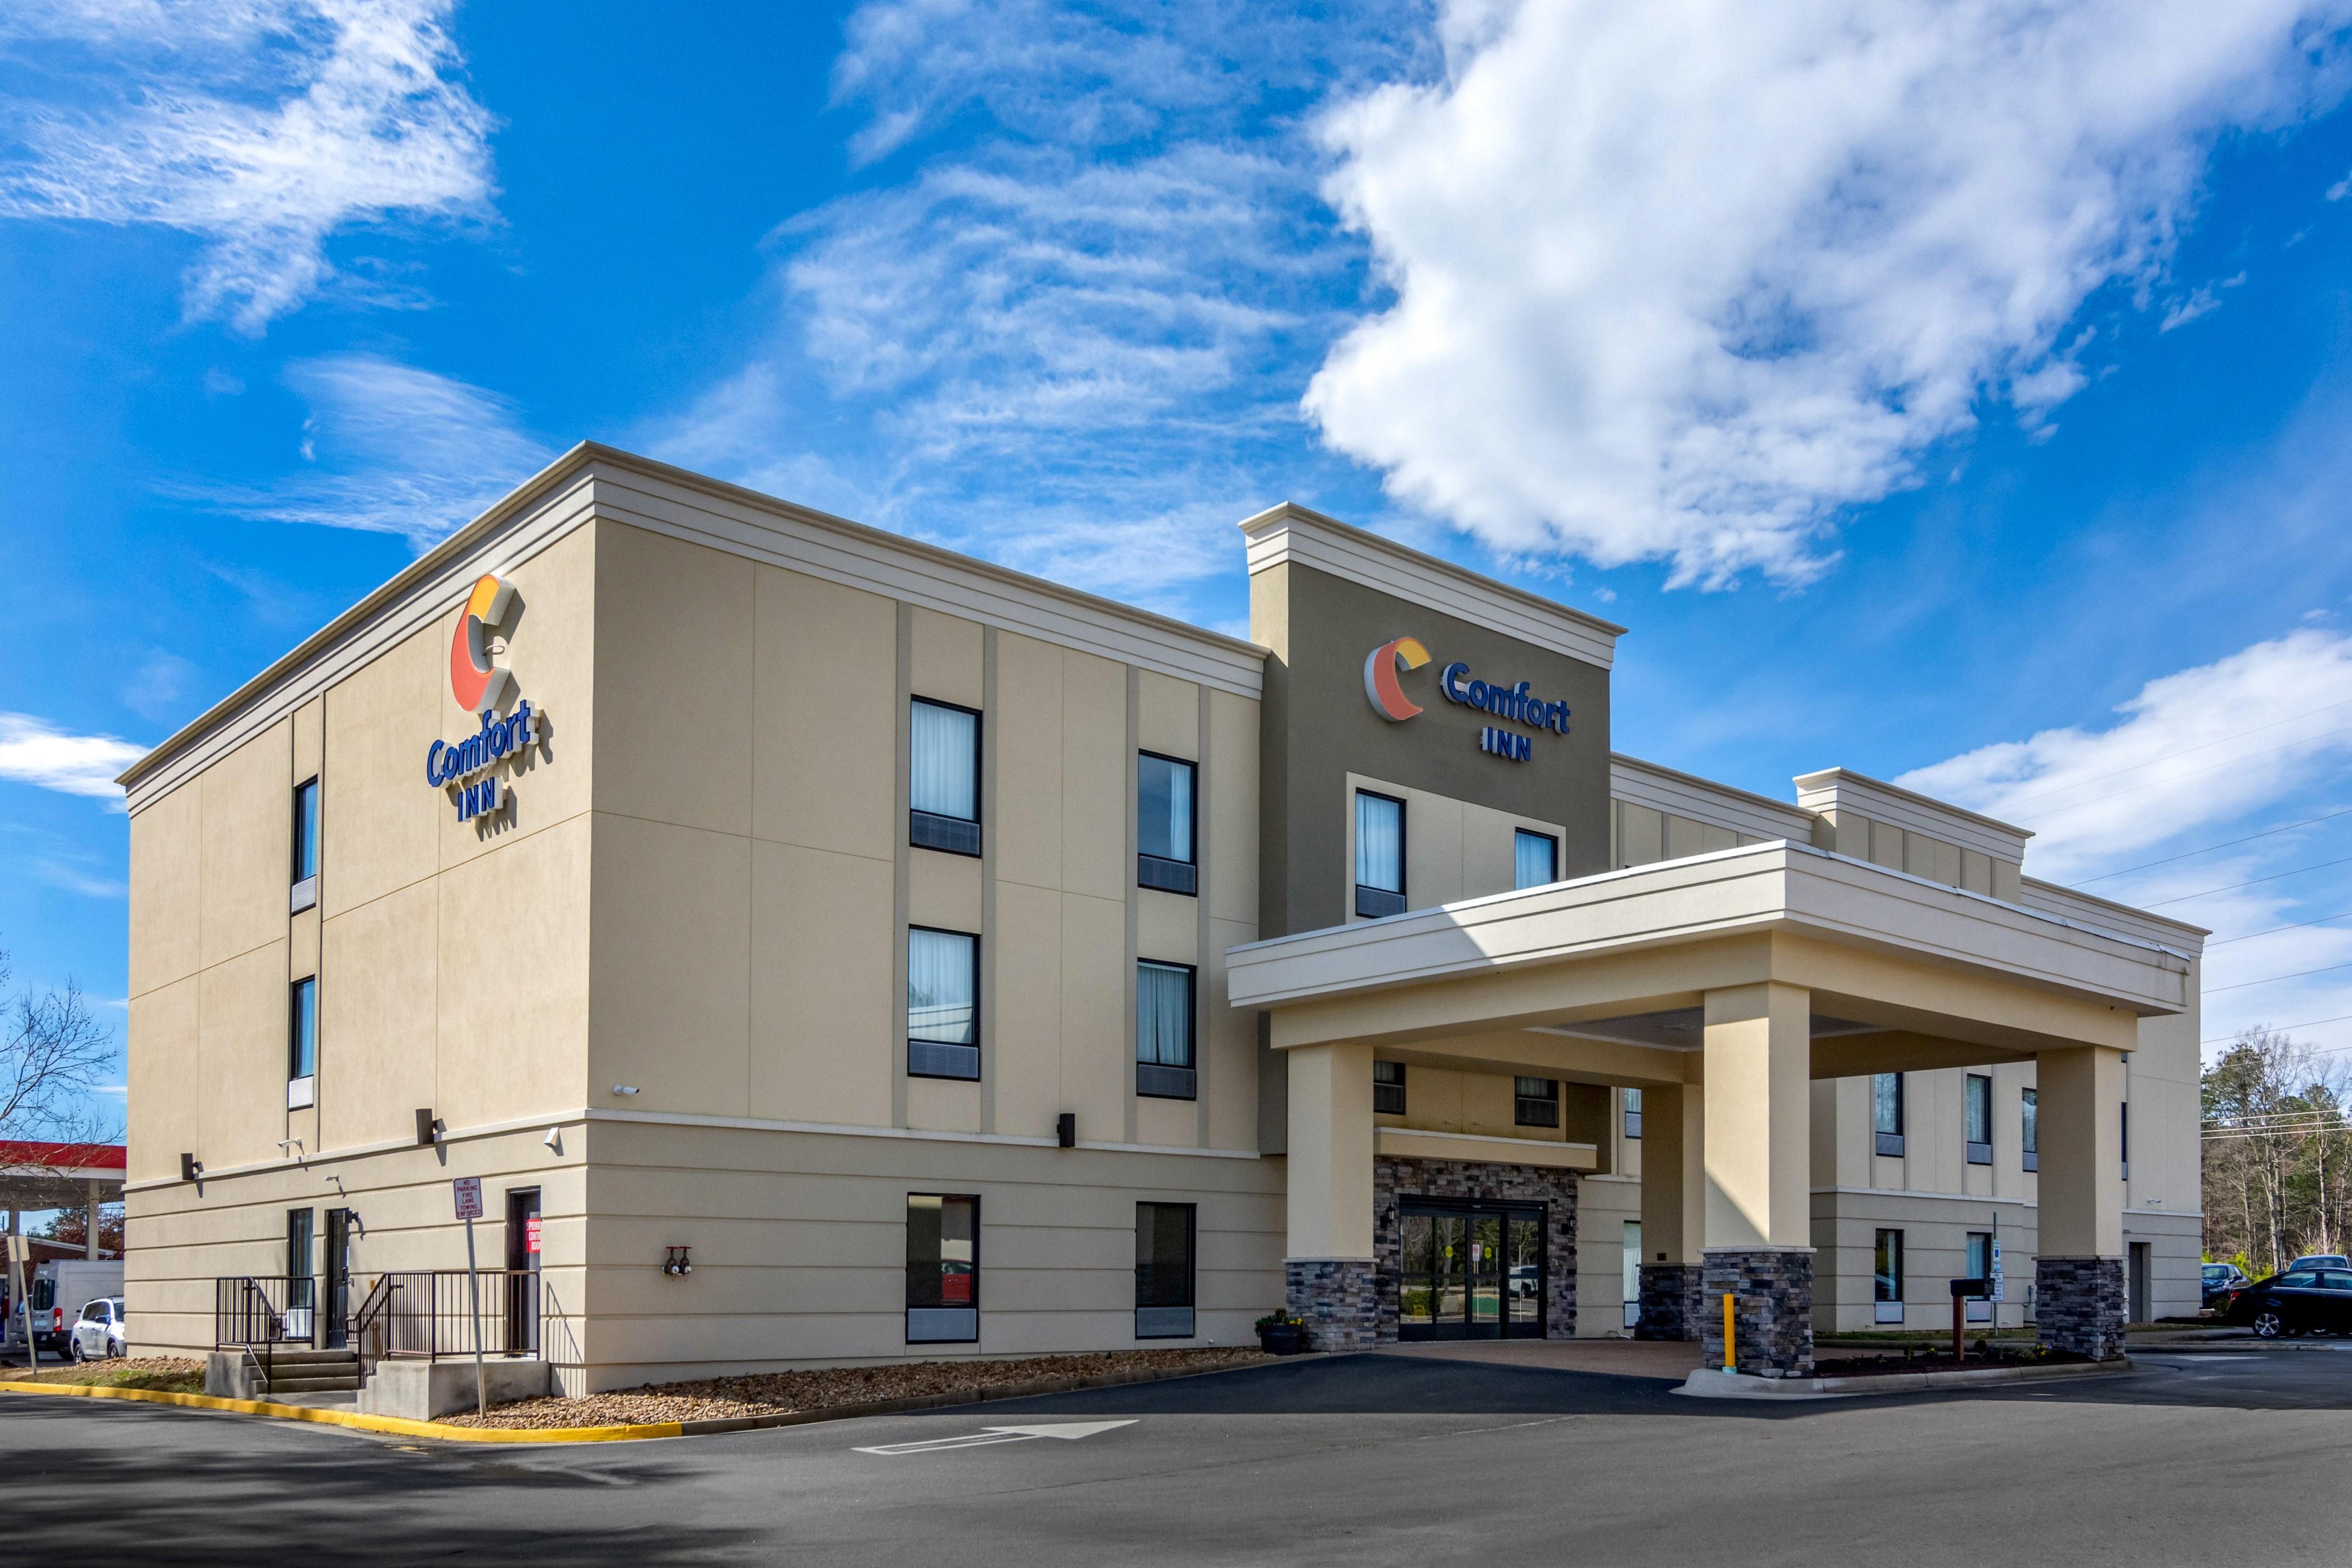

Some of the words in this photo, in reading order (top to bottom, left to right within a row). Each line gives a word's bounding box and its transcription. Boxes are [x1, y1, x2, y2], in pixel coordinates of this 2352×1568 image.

[1445, 662, 1570, 734] Comfort
[427, 699, 531, 787] Comfort
[1485, 726, 1531, 762] INN
[458, 776, 495, 823] INN
